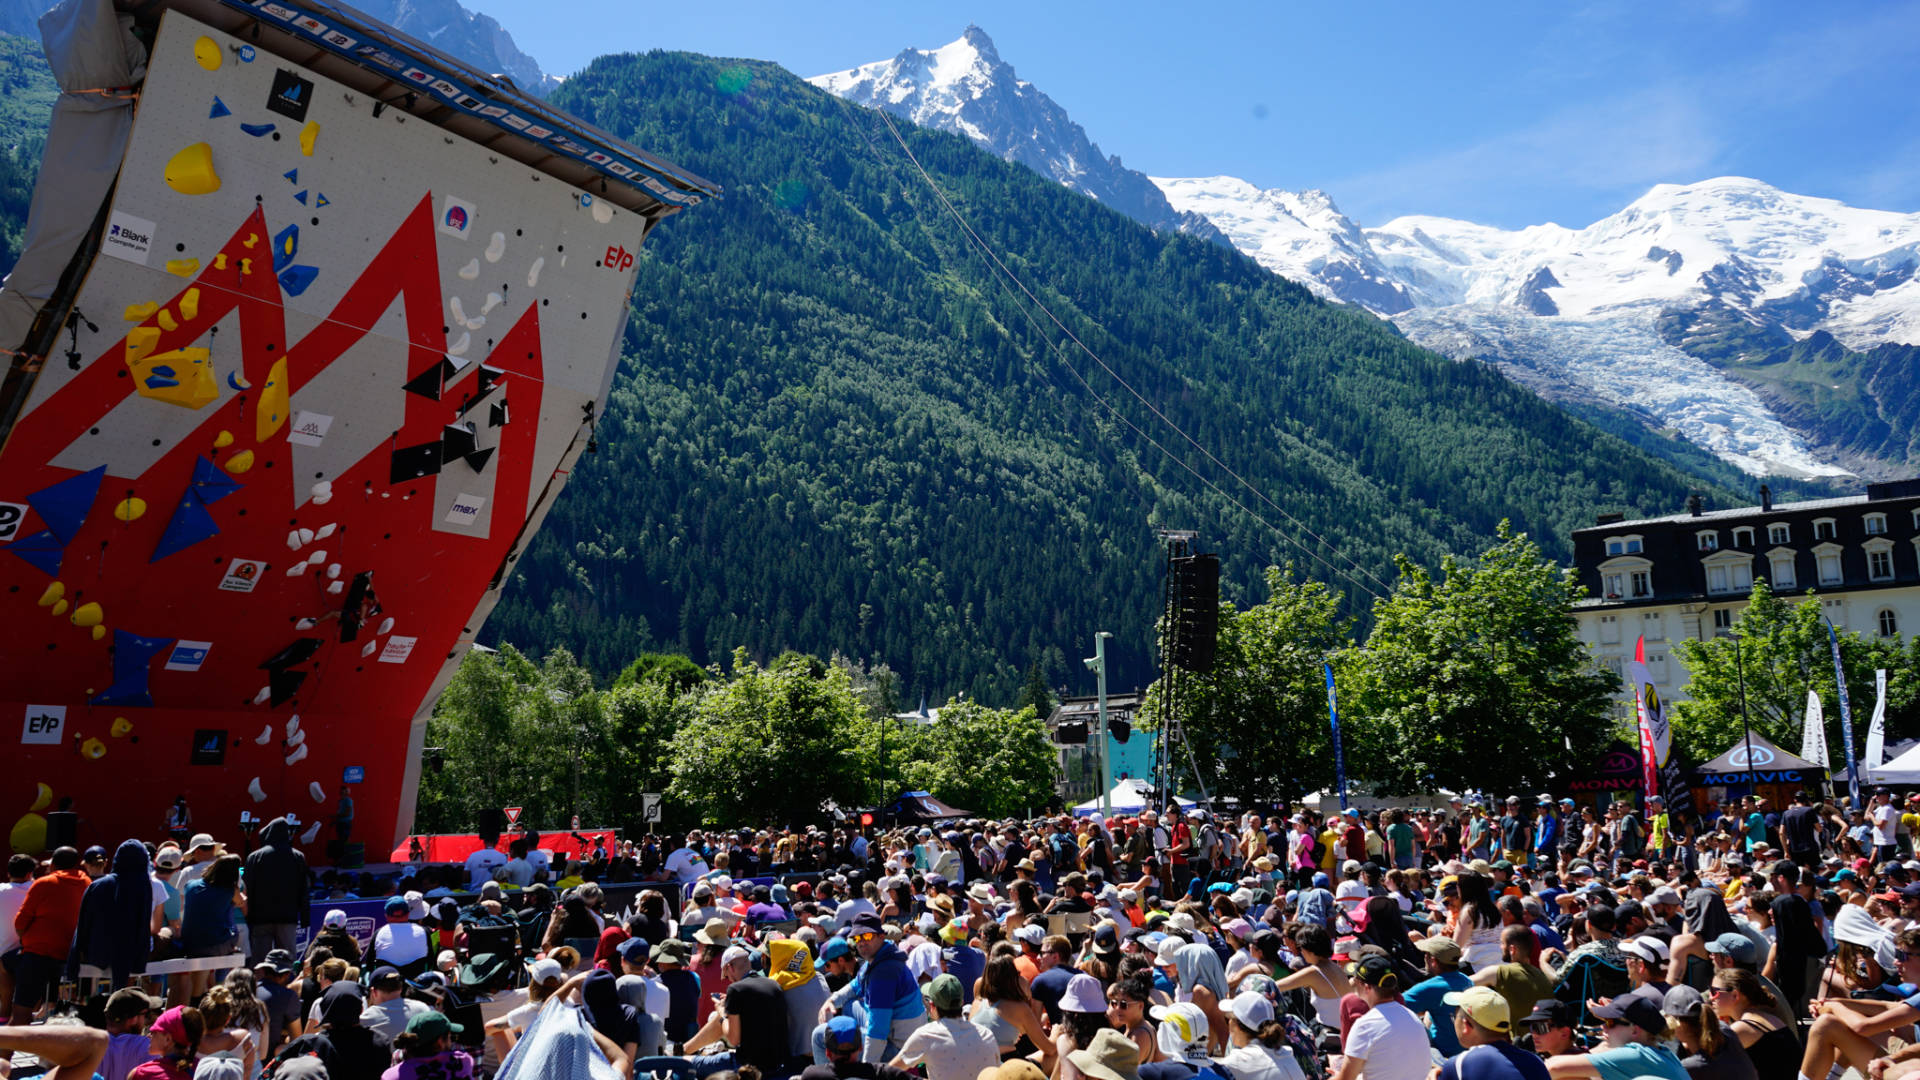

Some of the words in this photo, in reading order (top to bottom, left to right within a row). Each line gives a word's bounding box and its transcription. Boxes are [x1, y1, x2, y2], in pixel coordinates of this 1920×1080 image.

[242, 47, 255, 58] TOP
[121, 228, 149, 245] Blank
[1569, 778, 1643, 791] MONVI
[1702, 770, 1802, 785] MONVIC
